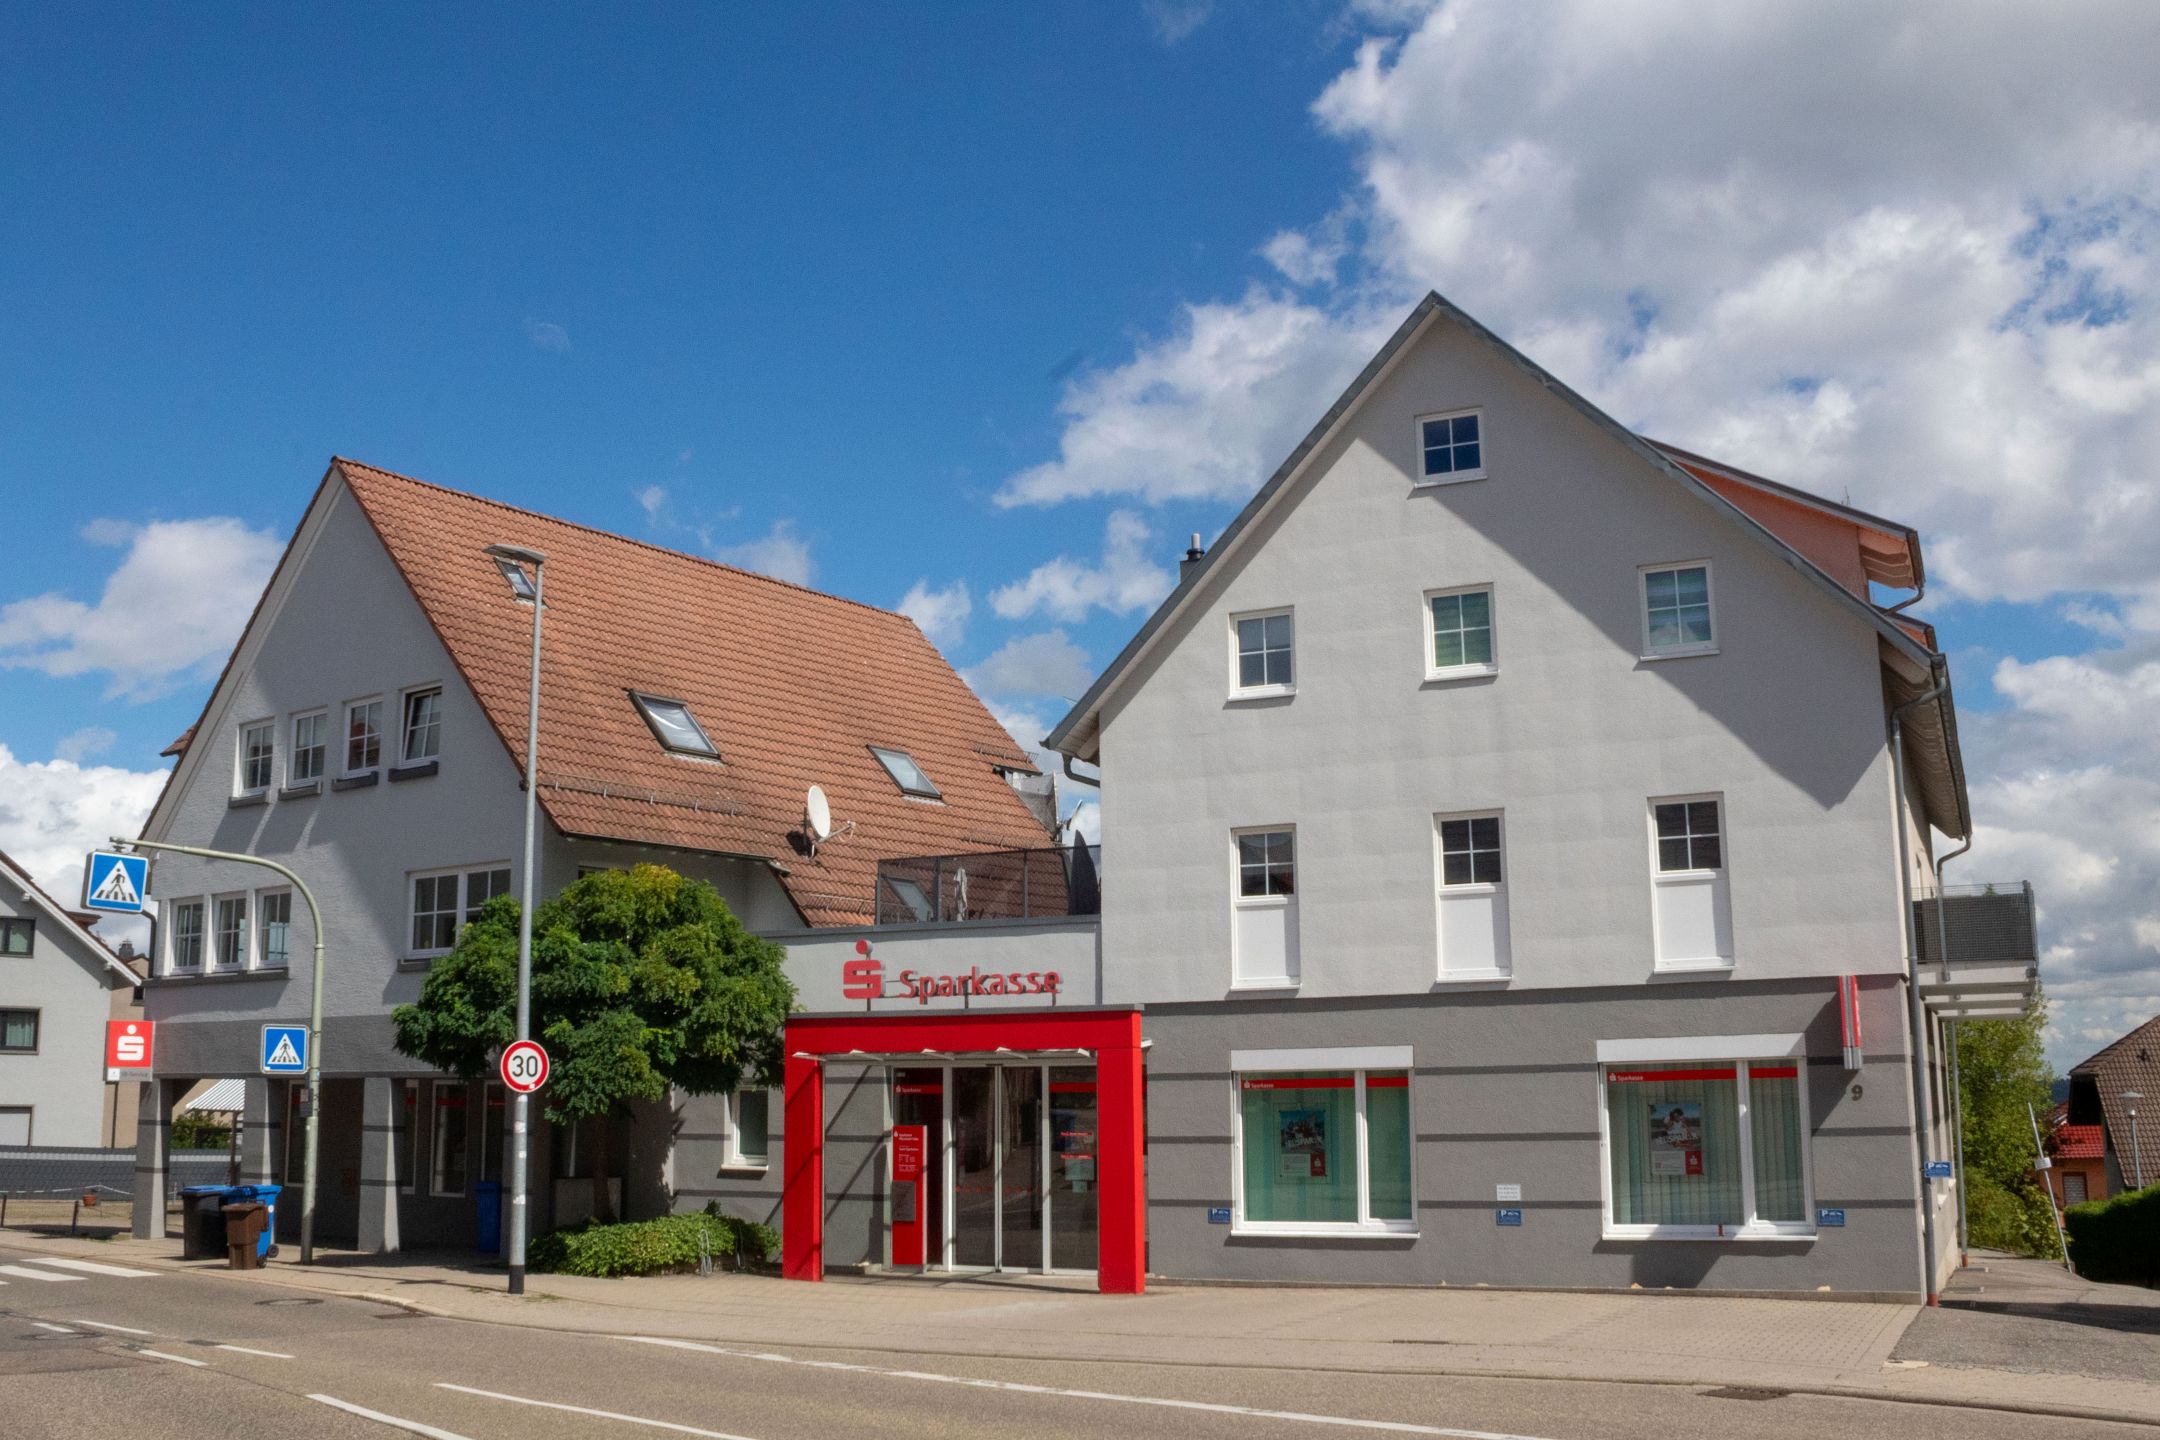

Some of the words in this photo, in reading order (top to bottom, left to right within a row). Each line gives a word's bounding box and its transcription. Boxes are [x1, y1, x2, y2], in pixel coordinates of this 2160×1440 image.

[899, 965, 1062, 1005] Sparkasse
[512, 1055, 538, 1077] 30
[1851, 1085, 1863, 1101] 9
